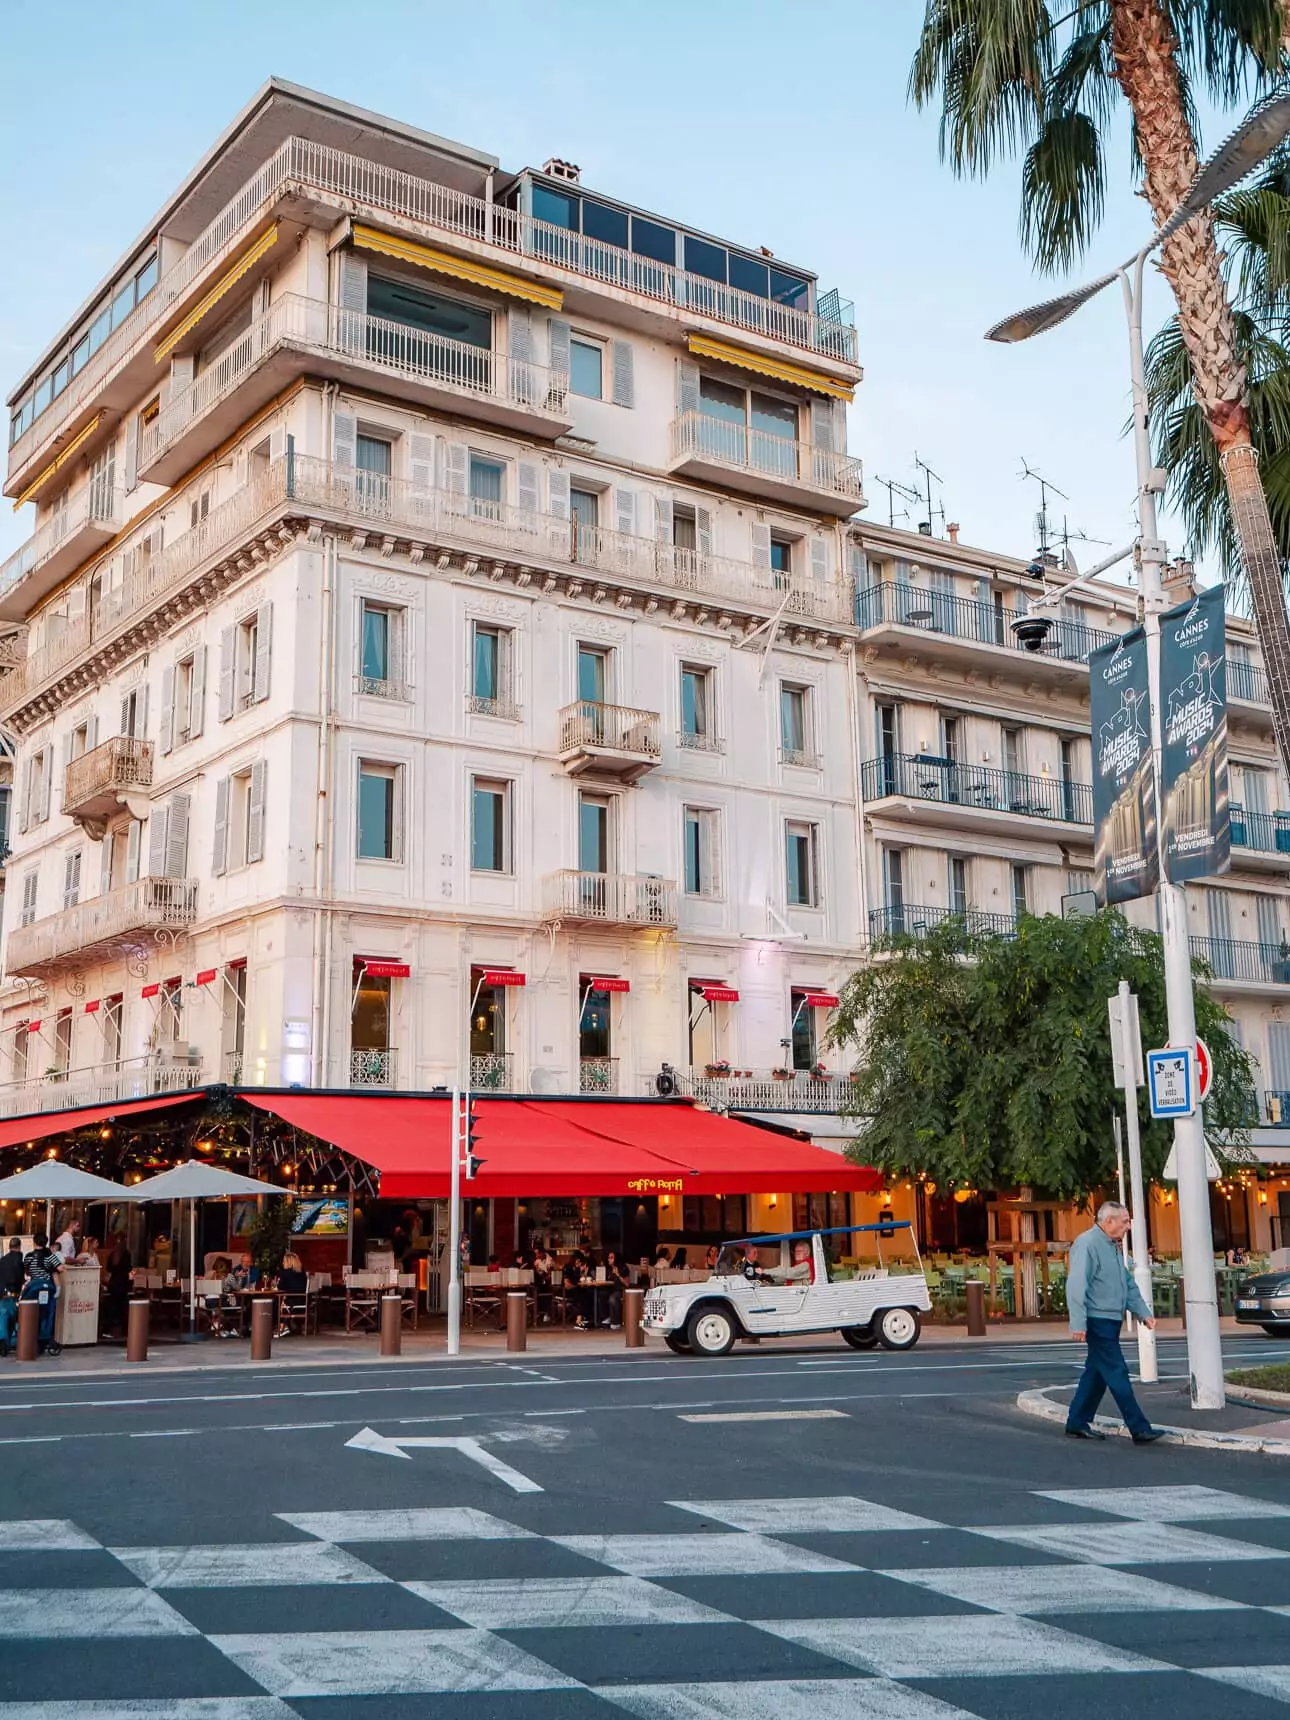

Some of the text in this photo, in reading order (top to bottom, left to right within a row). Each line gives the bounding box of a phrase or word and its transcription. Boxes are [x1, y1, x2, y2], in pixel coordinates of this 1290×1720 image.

[1174, 618, 1209, 642] CANNES
[1102, 656, 1133, 679] CANNES
[1171, 692, 1206, 729] MUSIC
[1167, 703, 1213, 745] AWARDS
[1185, 715, 1215, 747] 2024
[1101, 735, 1139, 776] AWARDS
[1103, 726, 1133, 760] MUSIC
[1115, 747, 1141, 776] 2024
[1174, 829, 1208, 843] VENDREDI
[1177, 836, 1215, 852] NOVEMBRE
[1111, 852, 1141, 867] VENDREDI
[1115, 859, 1147, 876] NOVEMBRE
